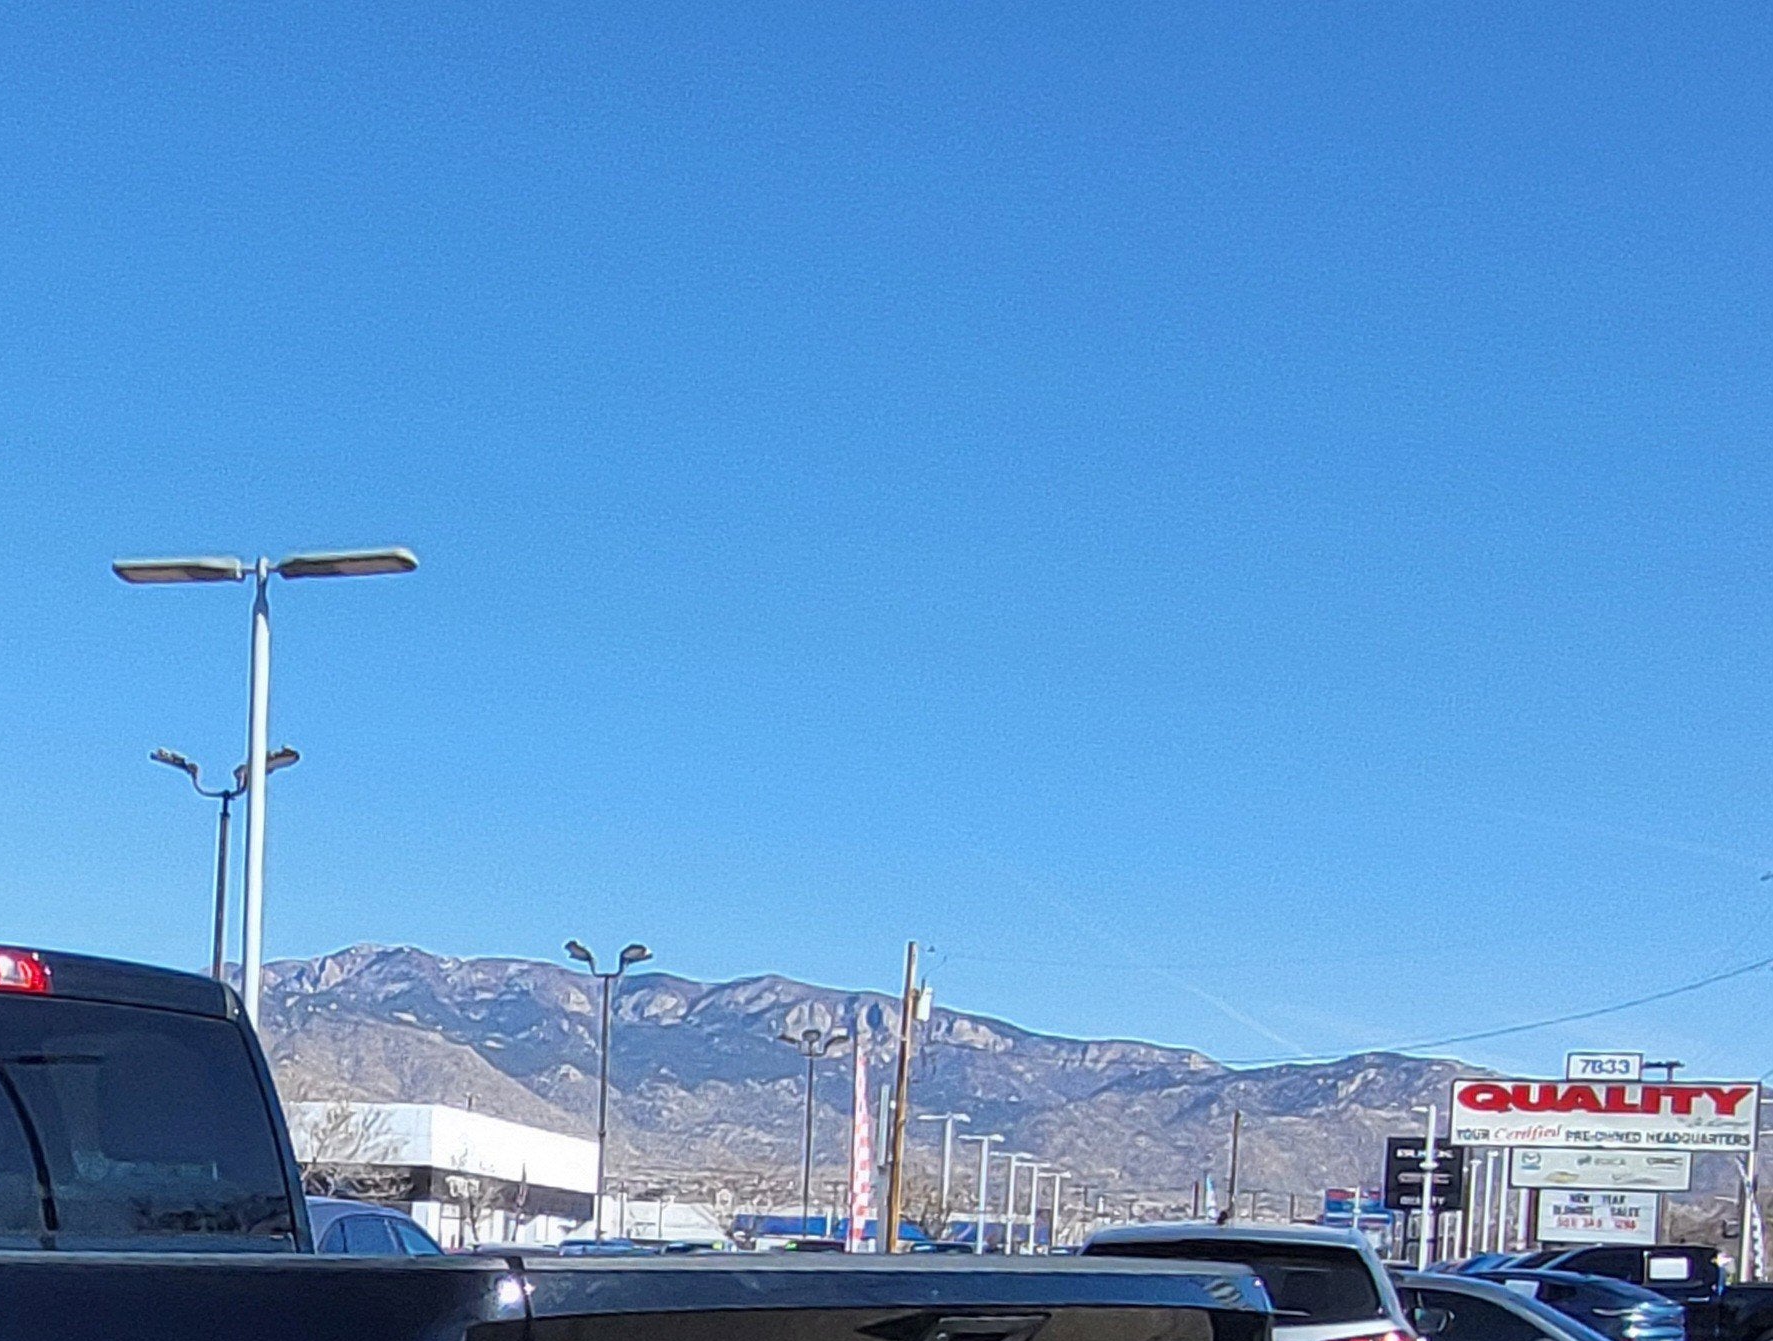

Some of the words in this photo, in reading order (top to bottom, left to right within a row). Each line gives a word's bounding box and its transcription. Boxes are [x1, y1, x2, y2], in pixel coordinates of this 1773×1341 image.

[1457, 1083, 1753, 1116] QUALITY
[1494, 1123, 1563, 1141] Certified
[1645, 1132, 1751, 1147] HEADQUARTERS
